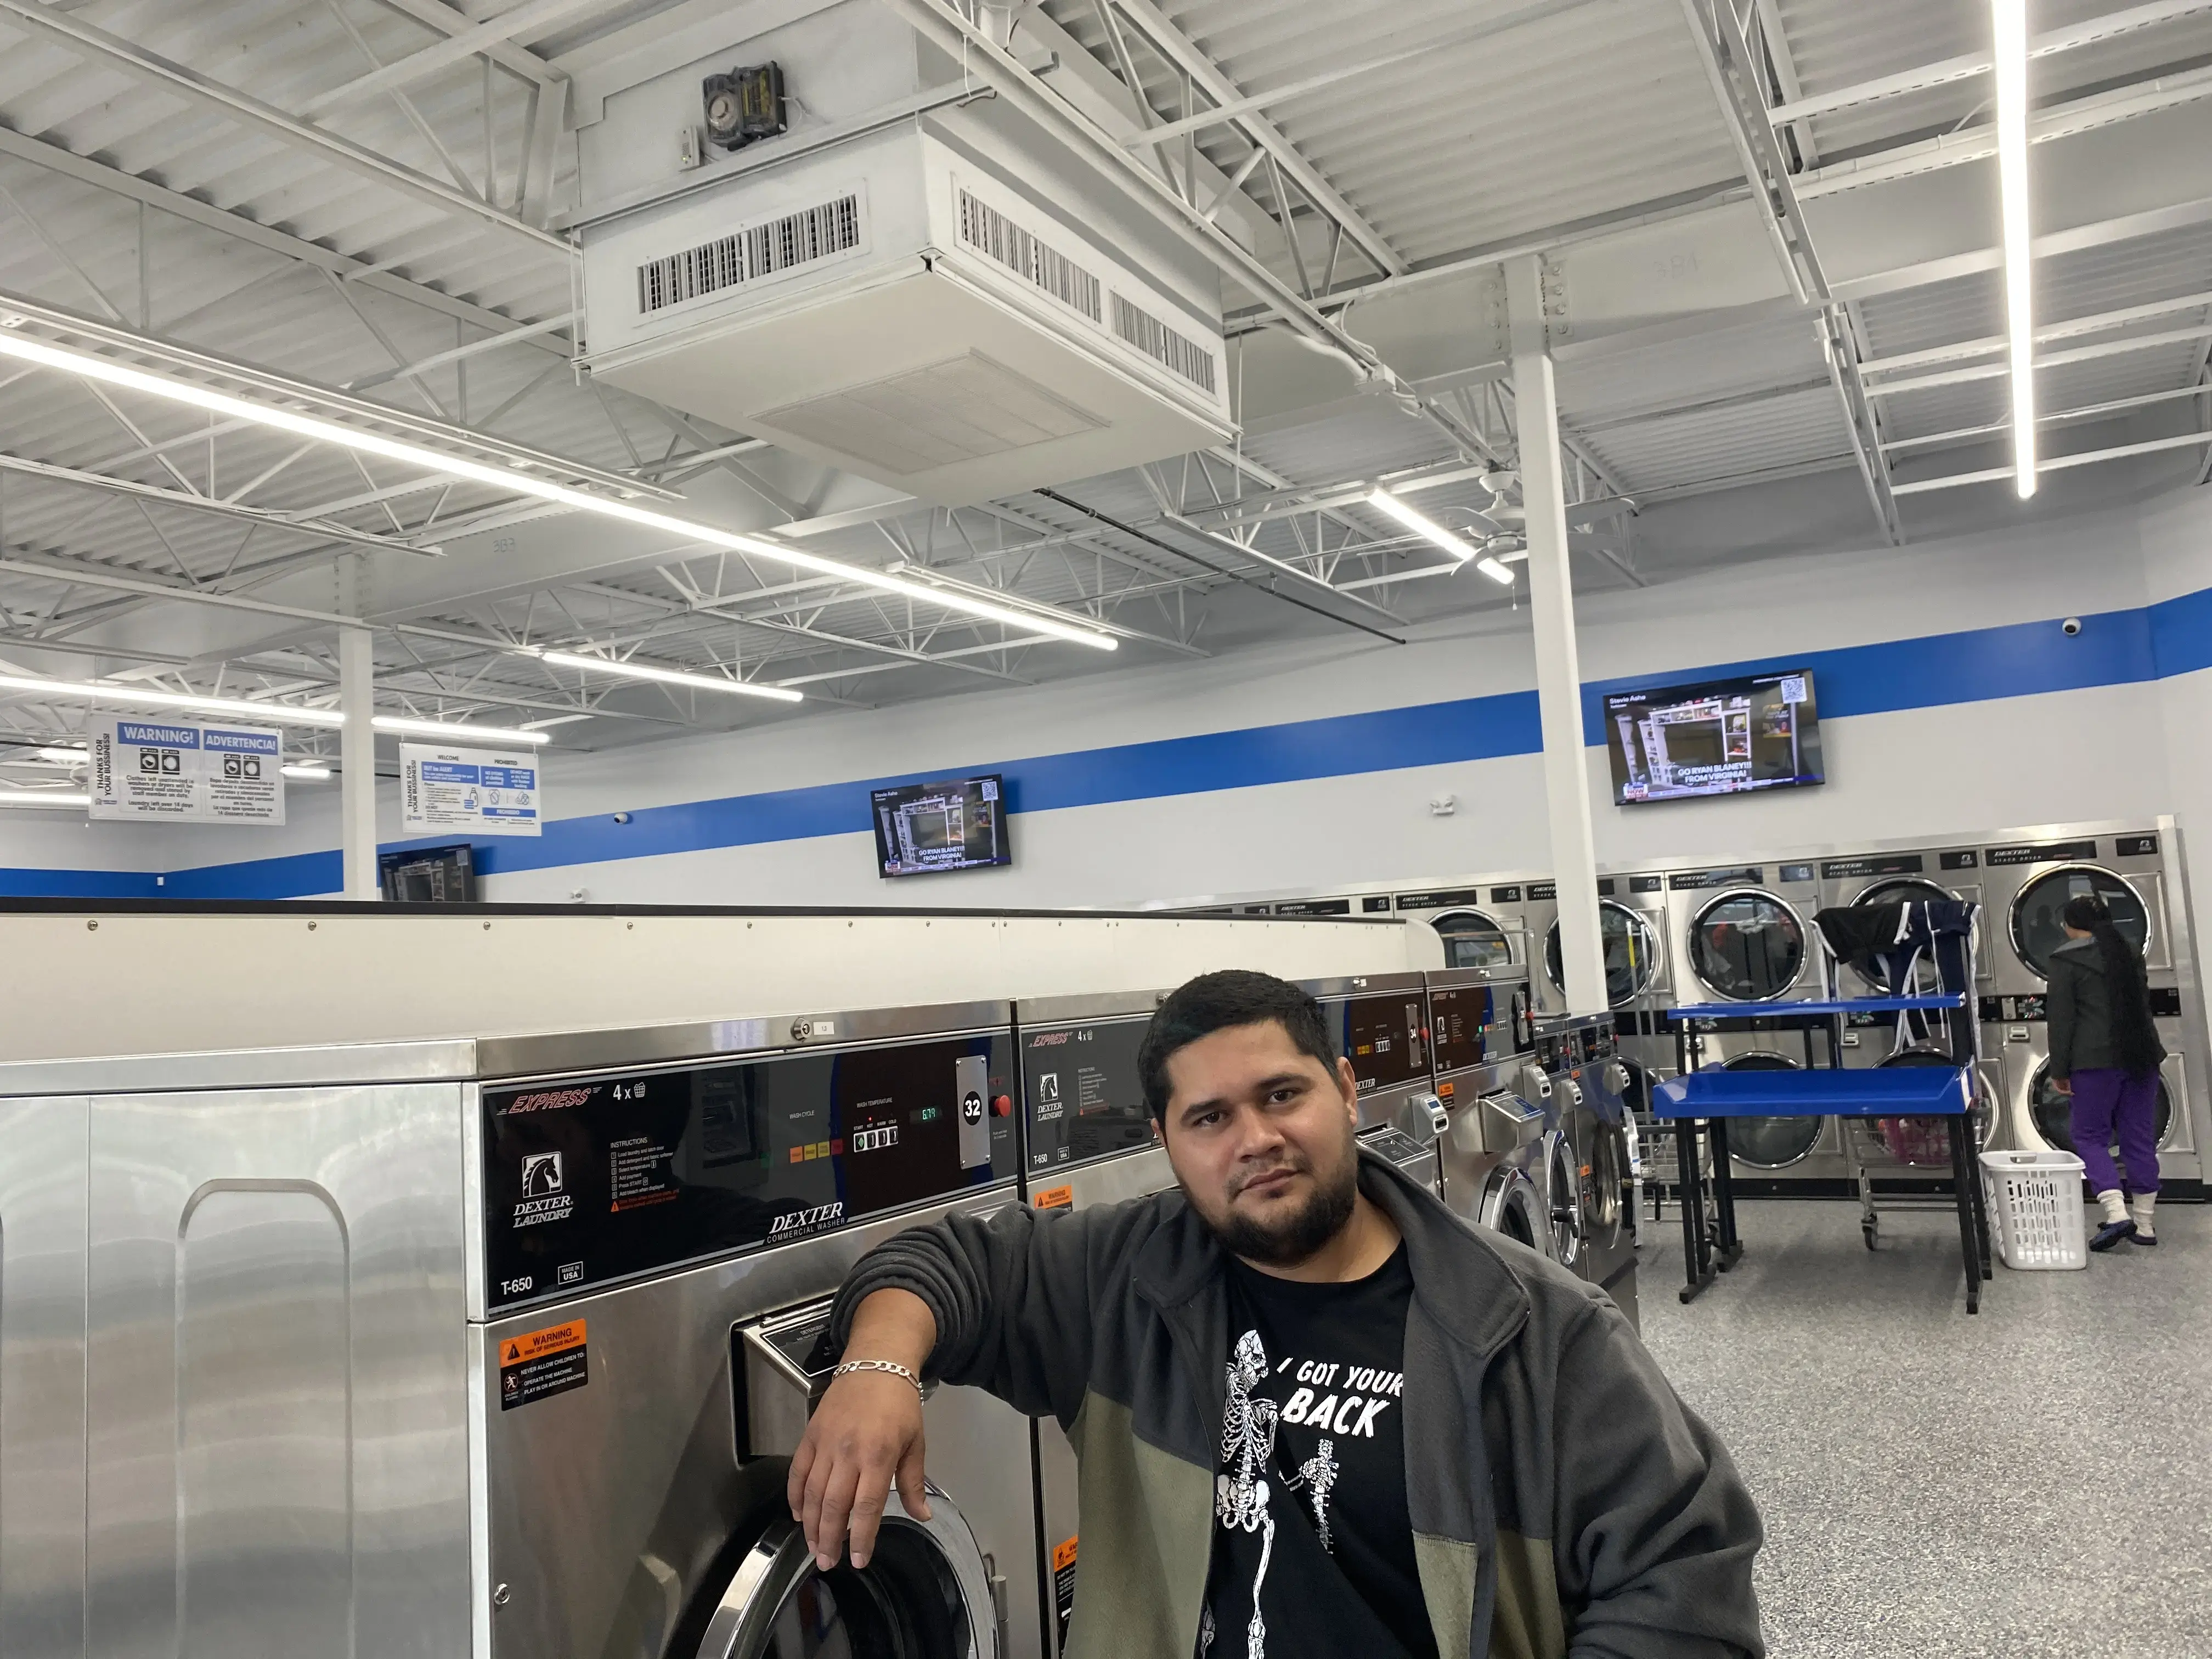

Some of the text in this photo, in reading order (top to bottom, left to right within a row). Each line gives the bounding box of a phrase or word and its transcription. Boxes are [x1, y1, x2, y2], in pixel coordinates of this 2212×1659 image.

[124, 726, 194, 744] WARNING!
[206, 735, 275, 750] ADVERTENCIA!
[1678, 768, 1691, 776] GO
[1691, 765, 1713, 774] RYAN
[1685, 770, 1747, 783] FROM VIRGINIA!
[938, 852, 962, 860] VIRGINIA!
[1032, 1032, 1069, 1047] EXPRESS
[1410, 1028, 1417, 1039] 34
[509, 1088, 592, 1114] EXPRESS
[964, 1099, 981, 1118] 32
[1037, 1102, 1062, 1114] DEXTER
[1037, 1110, 1063, 1121] LAUNDRY
[611, 1137, 647, 1148] INSTRUCTIONS
[1034, 1153, 1047, 1165] T-650
[1048, 1189, 1065, 1199] WARNING
[514, 1195, 570, 1216] DEXTER
[513, 1207, 573, 1228] LAUNDRY
[769, 1201, 844, 1234] DEXTER
[766, 1216, 845, 1244] COMMERCIAL WASHER
[561, 1265, 573, 1273] MADE
[563, 1270, 578, 1280] USA
[501, 1276, 533, 1295] T-650
[533, 1328, 572, 1346] WARNING
[800, 1324, 825, 1335] DETERGENT
[544, 1340, 563, 1350] SERIOUS
[521, 1365, 537, 1375] NEVER
[538, 1361, 554, 1370] ALLOW
[554, 1355, 576, 1365] CHILDREN
[524, 1376, 544, 1386] OPERATE
[554, 1367, 572, 1377] MACHINE
[548, 1378, 566, 1387] AROUND
[567, 1372, 585, 1381] MACHINE
[1277, 1357, 1403, 1397] I GOT YOUR
[1280, 1387, 1390, 1438] BACK
